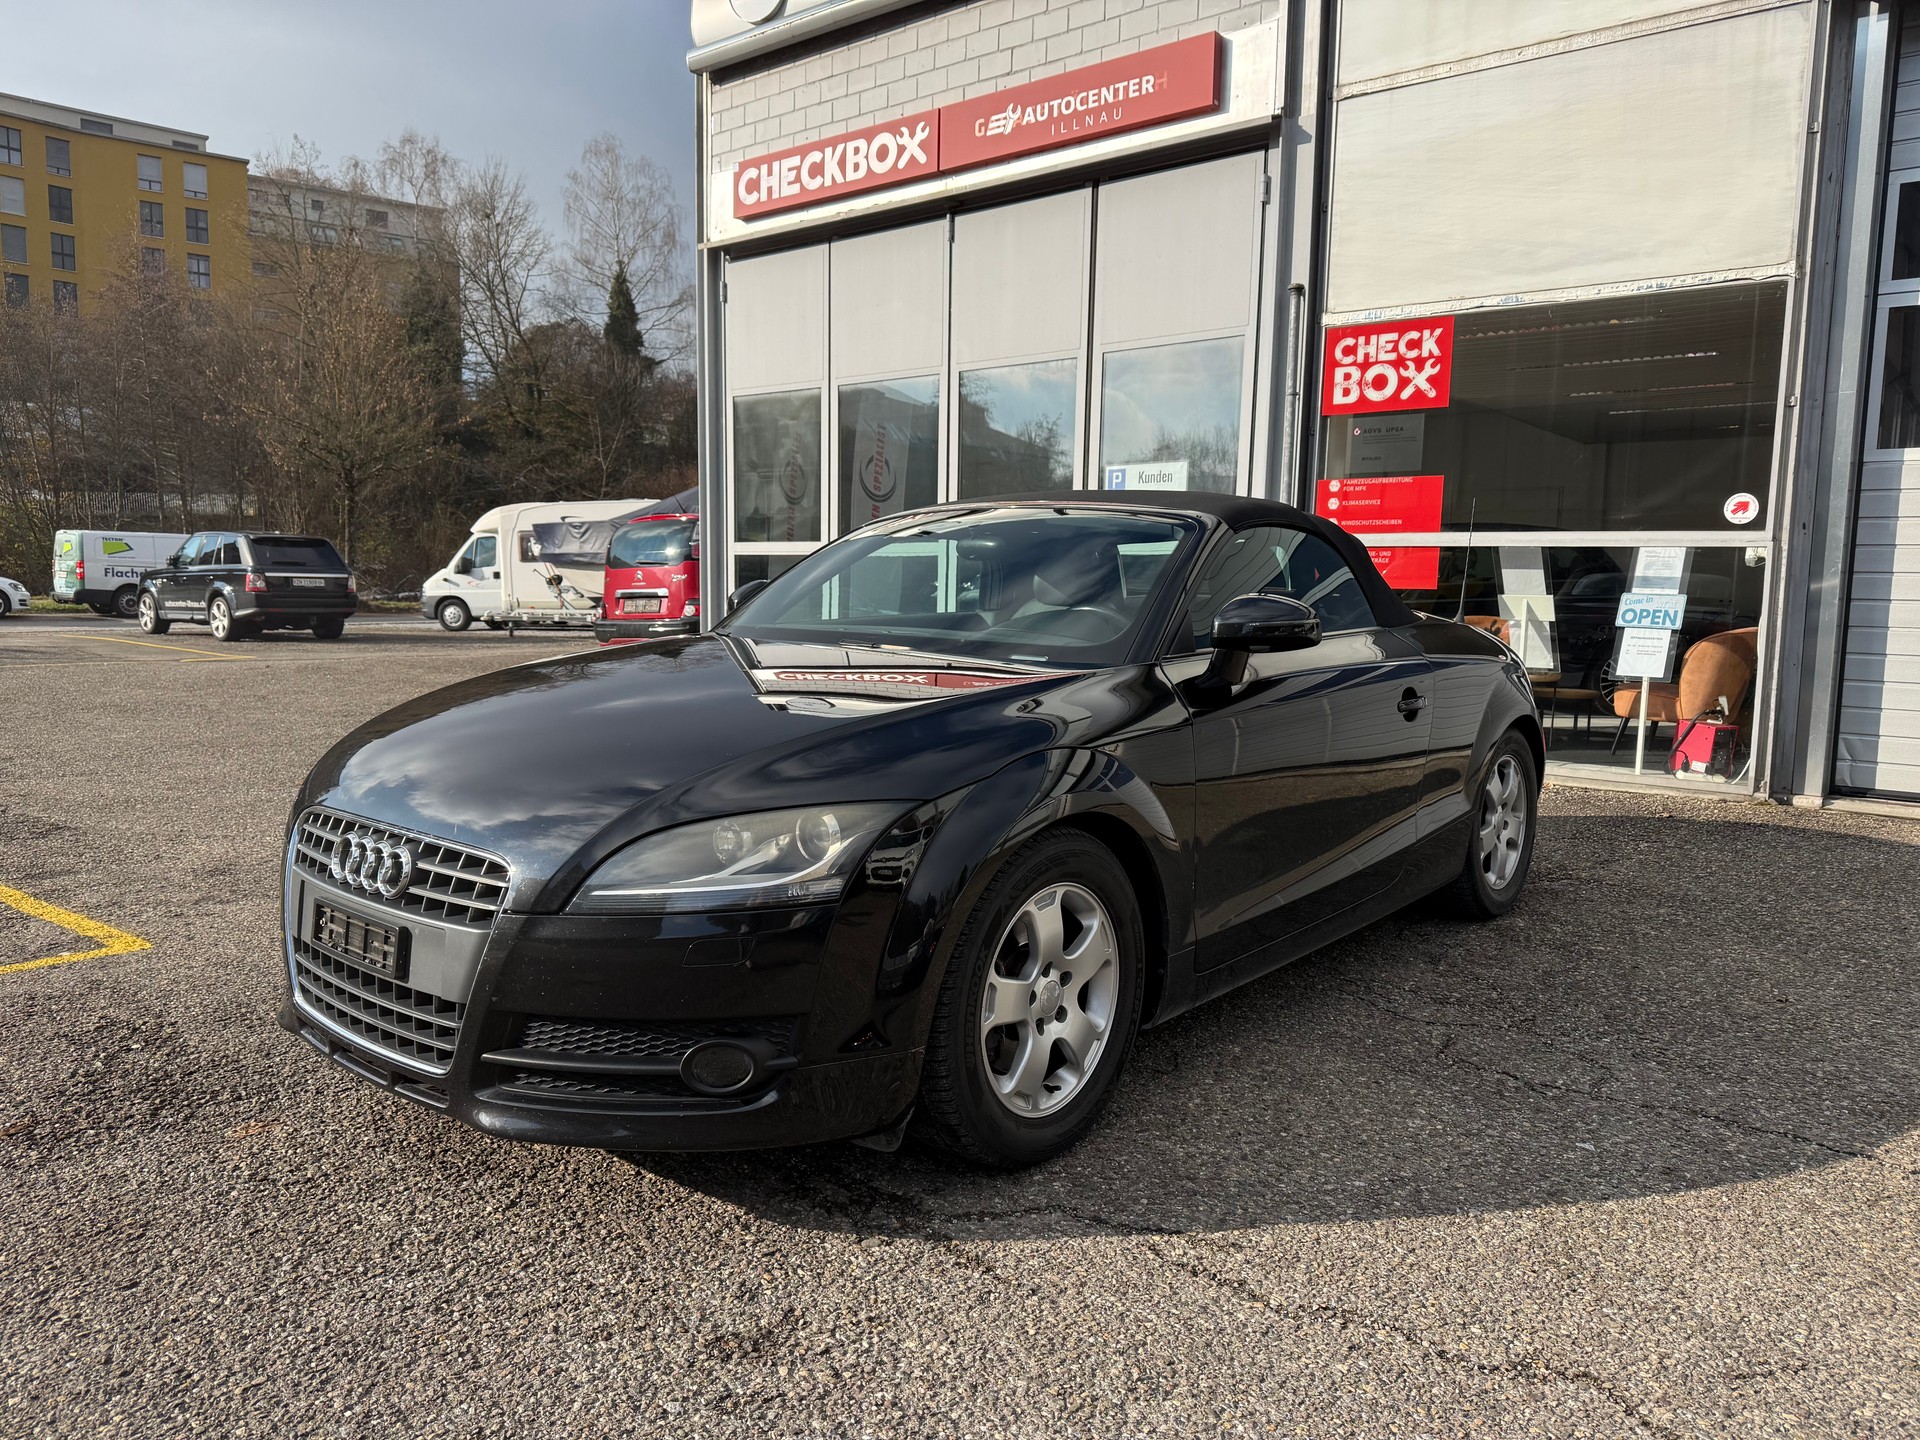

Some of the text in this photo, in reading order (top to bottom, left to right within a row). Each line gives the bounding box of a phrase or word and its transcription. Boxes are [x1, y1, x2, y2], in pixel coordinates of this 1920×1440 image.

[1023, 75, 1155, 125] AUTOCENTER
[1051, 106, 1123, 137] ILLNAU
[737, 121, 930, 206] CHECKBOX
[1334, 327, 1444, 365] CHECK
[1332, 358, 1442, 406] BOX
[1385, 425, 1404, 433] UPSA
[873, 423, 887, 492] SPEZIALIST
[1137, 470, 1173, 484] Kunden
[1343, 476, 1414, 485] FAHRZEUGAUFBEREITUNG
[1624, 595, 1654, 606] Come in
[1620, 608, 1679, 626] OPEN
